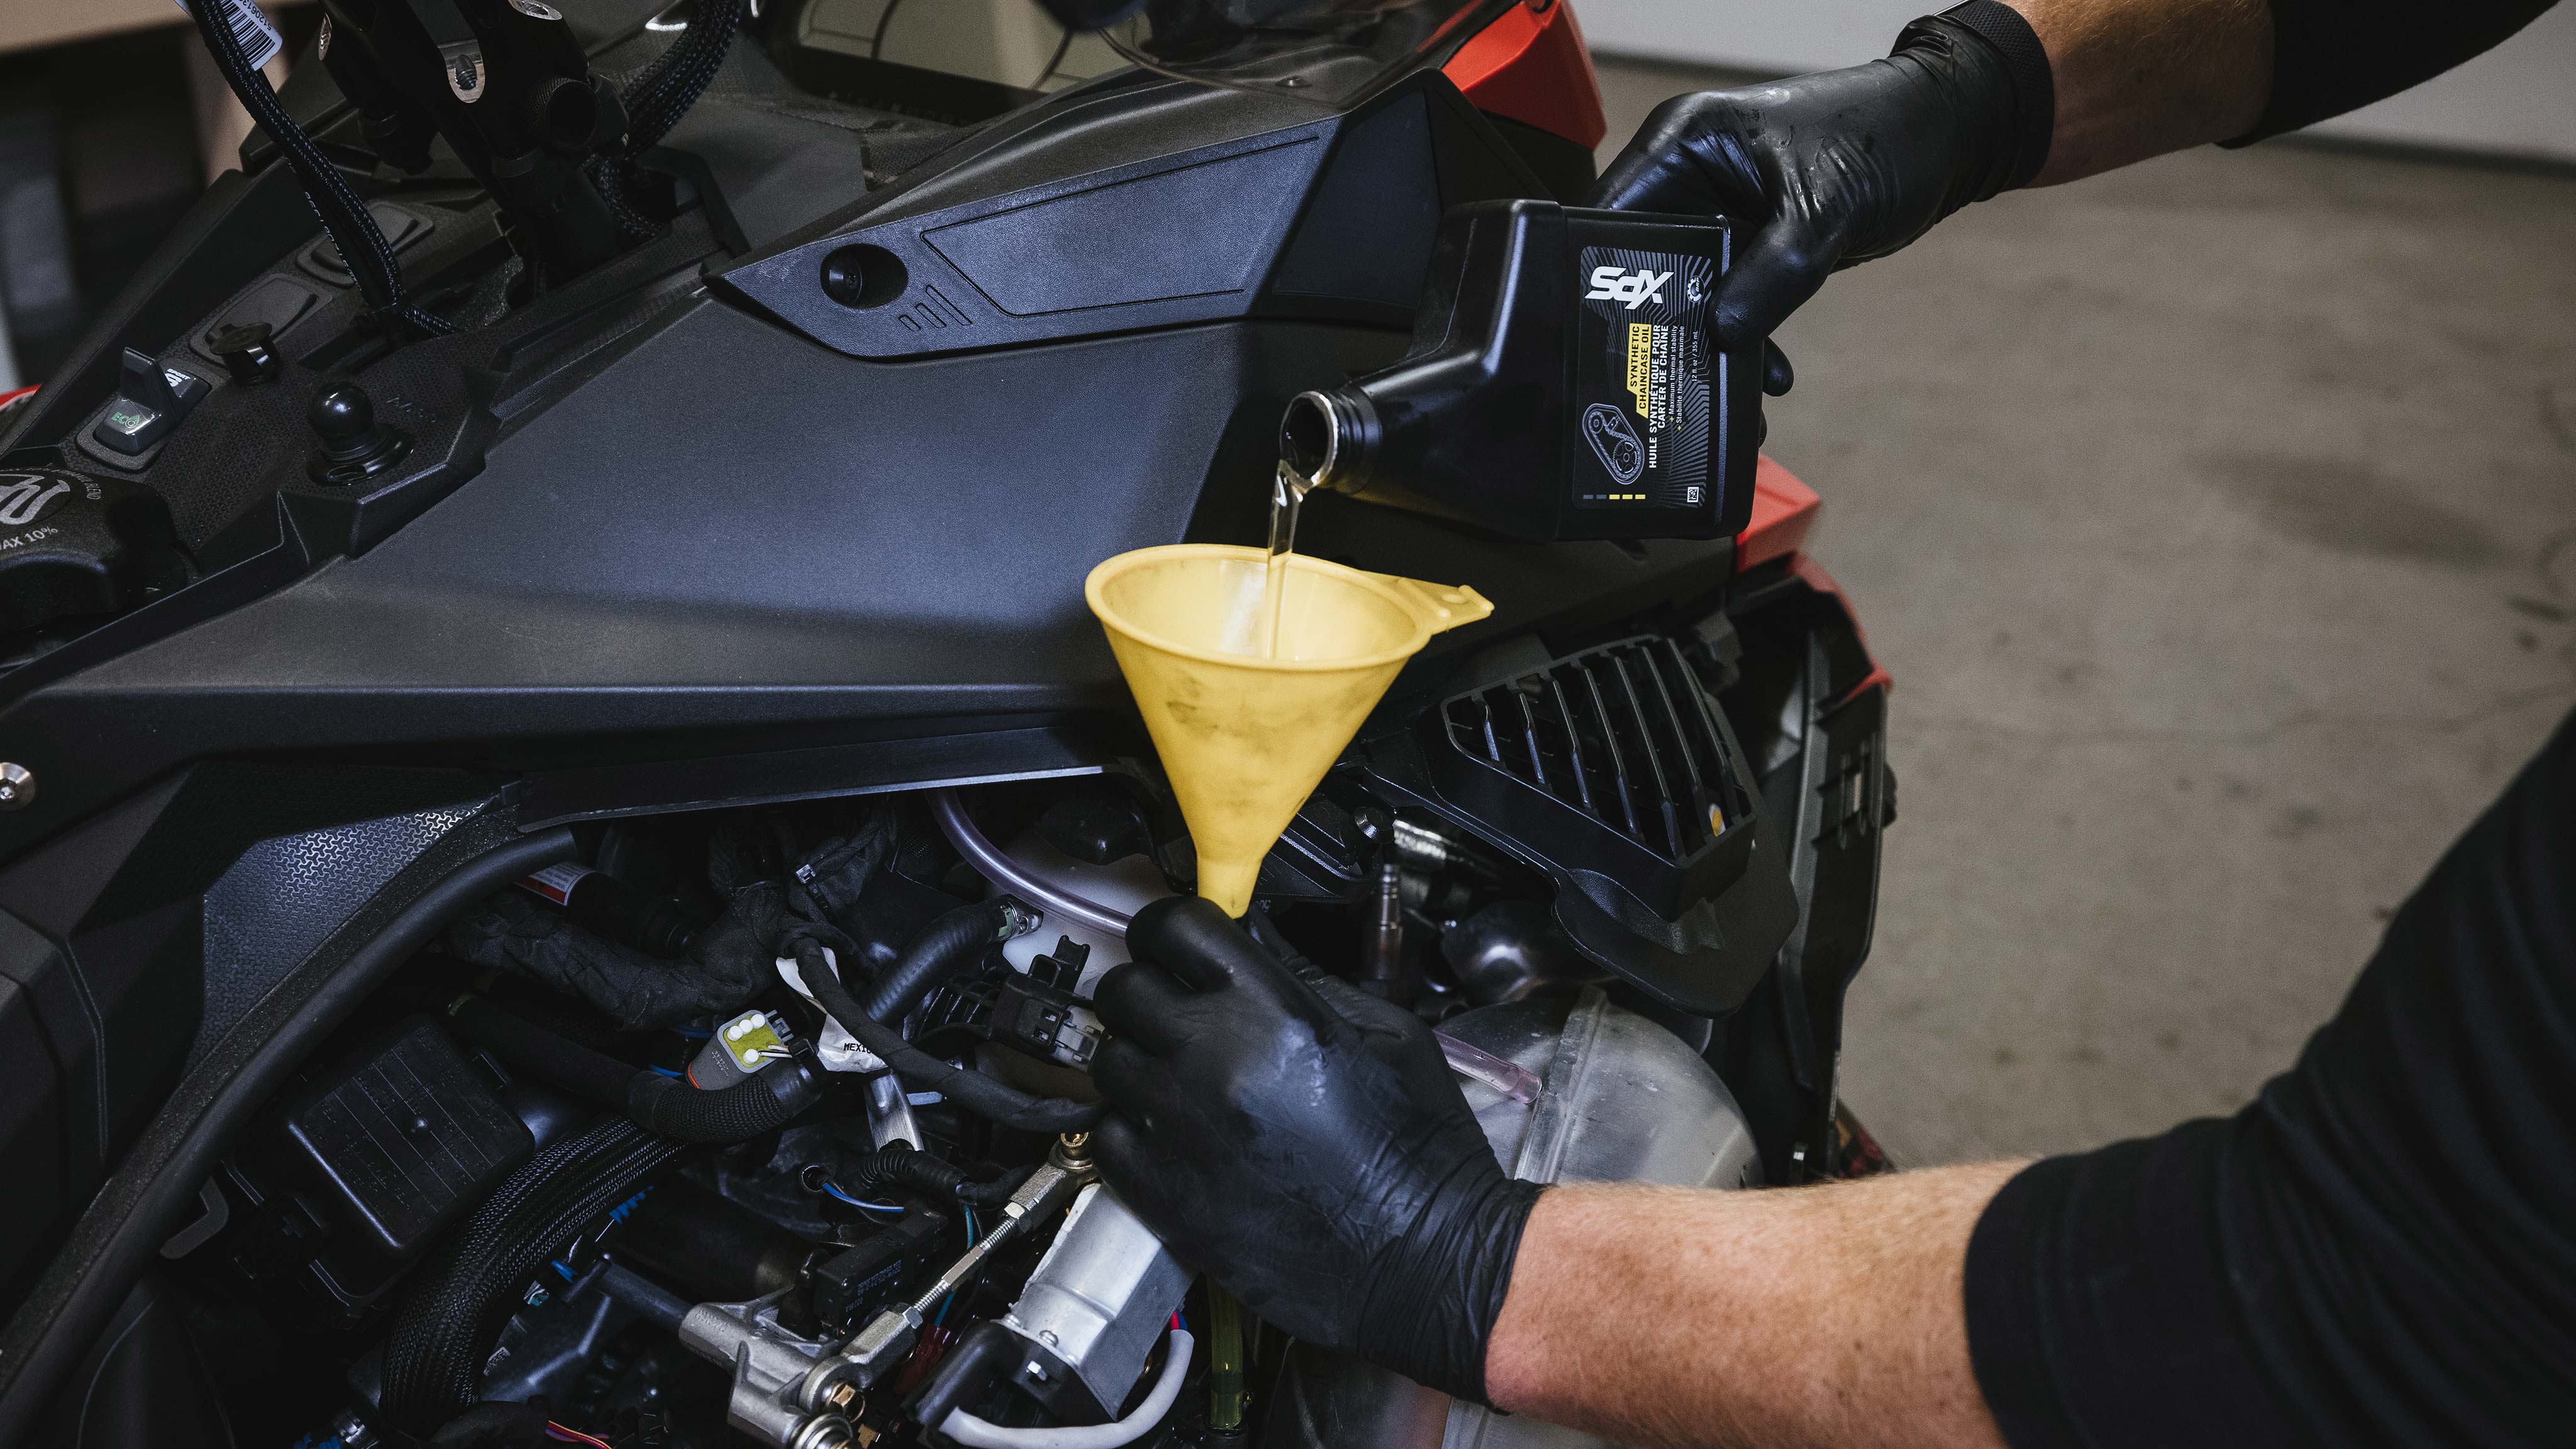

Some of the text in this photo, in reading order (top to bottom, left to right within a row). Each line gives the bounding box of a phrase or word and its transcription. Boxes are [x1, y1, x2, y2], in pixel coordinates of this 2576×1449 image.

[238, 0, 272, 31] 5120613
[1584, 265, 1674, 309] XPS
[1693, 330, 1698, 340] mL
[167, 368, 191, 380] SPORT
[1630, 326, 1640, 387] SYNTHETIC
[1639, 347, 1648, 409] CHAINCASE
[1658, 325, 1668, 428] CARTER DE CHAÎNE
[1649, 325, 1661, 468] HUILE SYNTHÉTIQUE POUR
[111, 411, 140, 428] ECO
[0, 526, 58, 550] AX 10%
